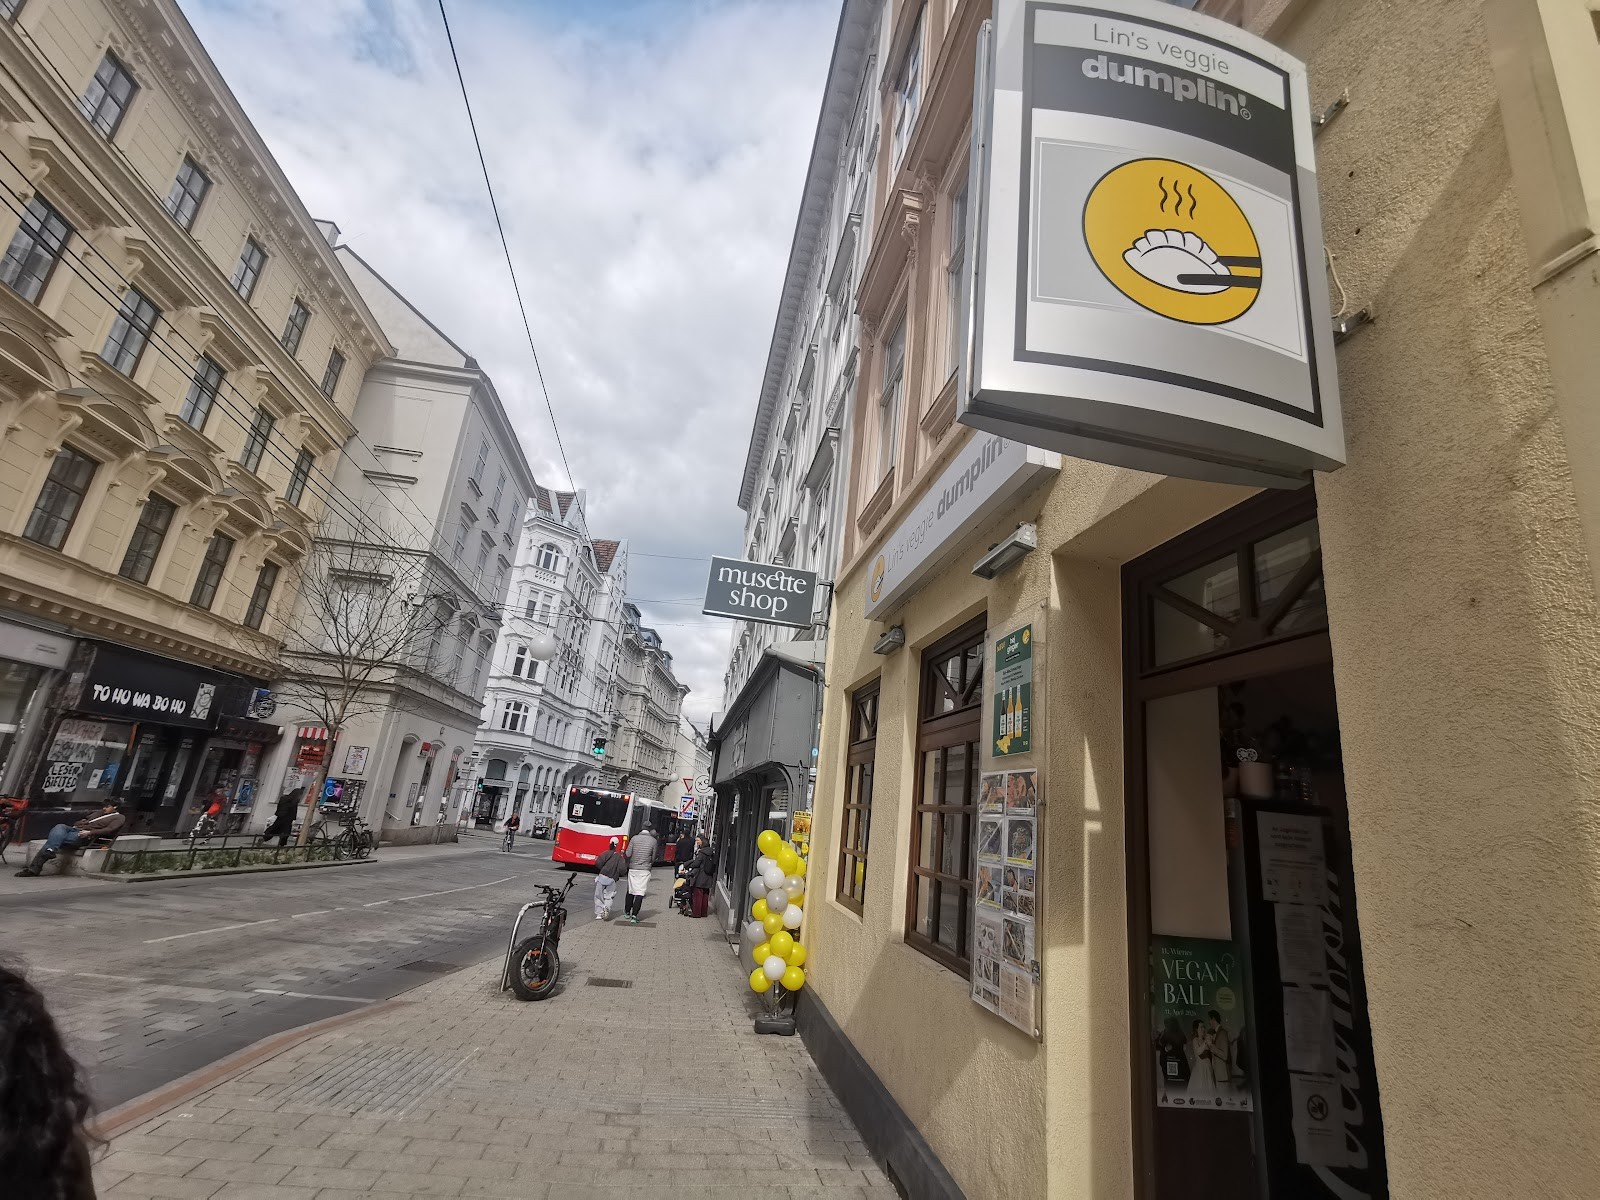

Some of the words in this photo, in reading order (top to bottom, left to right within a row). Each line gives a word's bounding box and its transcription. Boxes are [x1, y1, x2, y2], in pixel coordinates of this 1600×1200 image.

[1093, 23, 1149, 50] Lin's
[1157, 41, 1230, 75] veggie
[887, 542, 905, 573] Lin's
[905, 509, 934, 552] veggie
[717, 567, 807, 594] musette
[728, 586, 788, 618] shop
[93, 683, 111, 701] TO
[111, 687, 132, 705] HO
[132, 691, 151, 709] WA
[152, 695, 169, 712] BO
[169, 698, 187, 714] HO
[51, 764, 81, 776] LESEN
[1170, 947, 1193, 956] Wiener
[1161, 958, 1230, 984] VEGAN
[1163, 983, 1210, 1006] BALL
